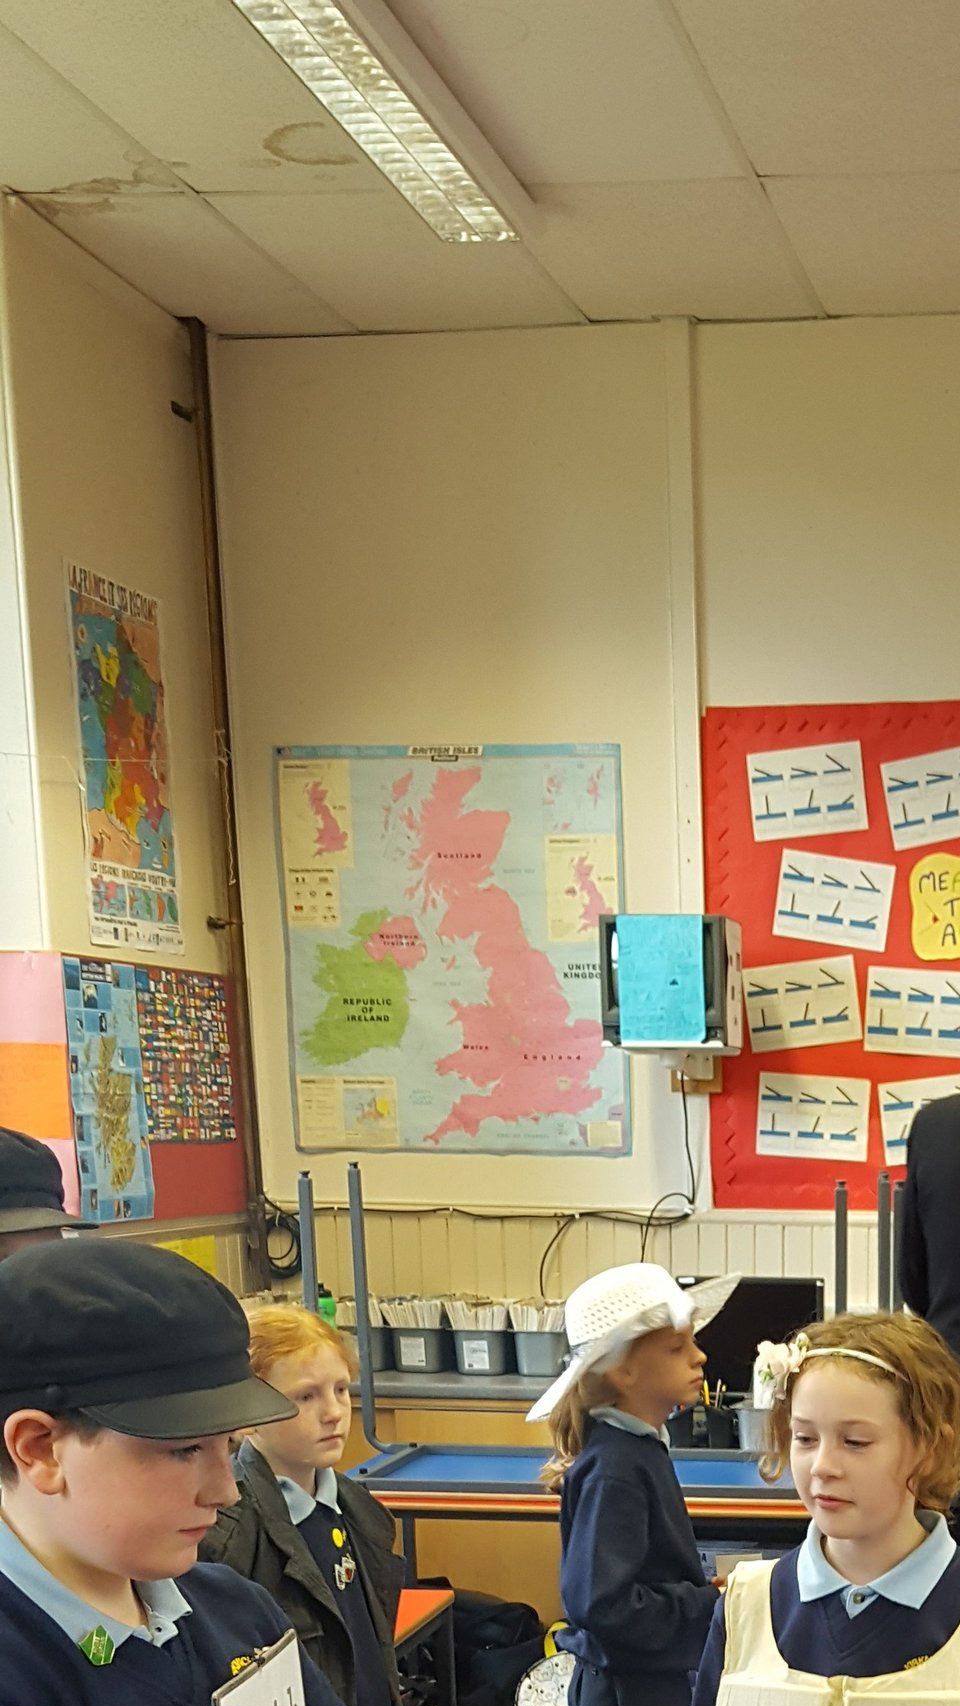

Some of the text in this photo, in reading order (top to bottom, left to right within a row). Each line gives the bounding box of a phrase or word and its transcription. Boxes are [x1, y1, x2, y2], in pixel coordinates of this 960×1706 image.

[412, 745, 479, 755] BRITISH ISLES
[437, 851, 482, 860] Scotland
[567, 963, 600, 971] UNITE
[563, 972, 600, 980] KINGDO
[342, 998, 392, 1006] REPUBLIC
[361, 1006, 374, 1014] OF
[346, 1014, 390, 1022] IRELAND
